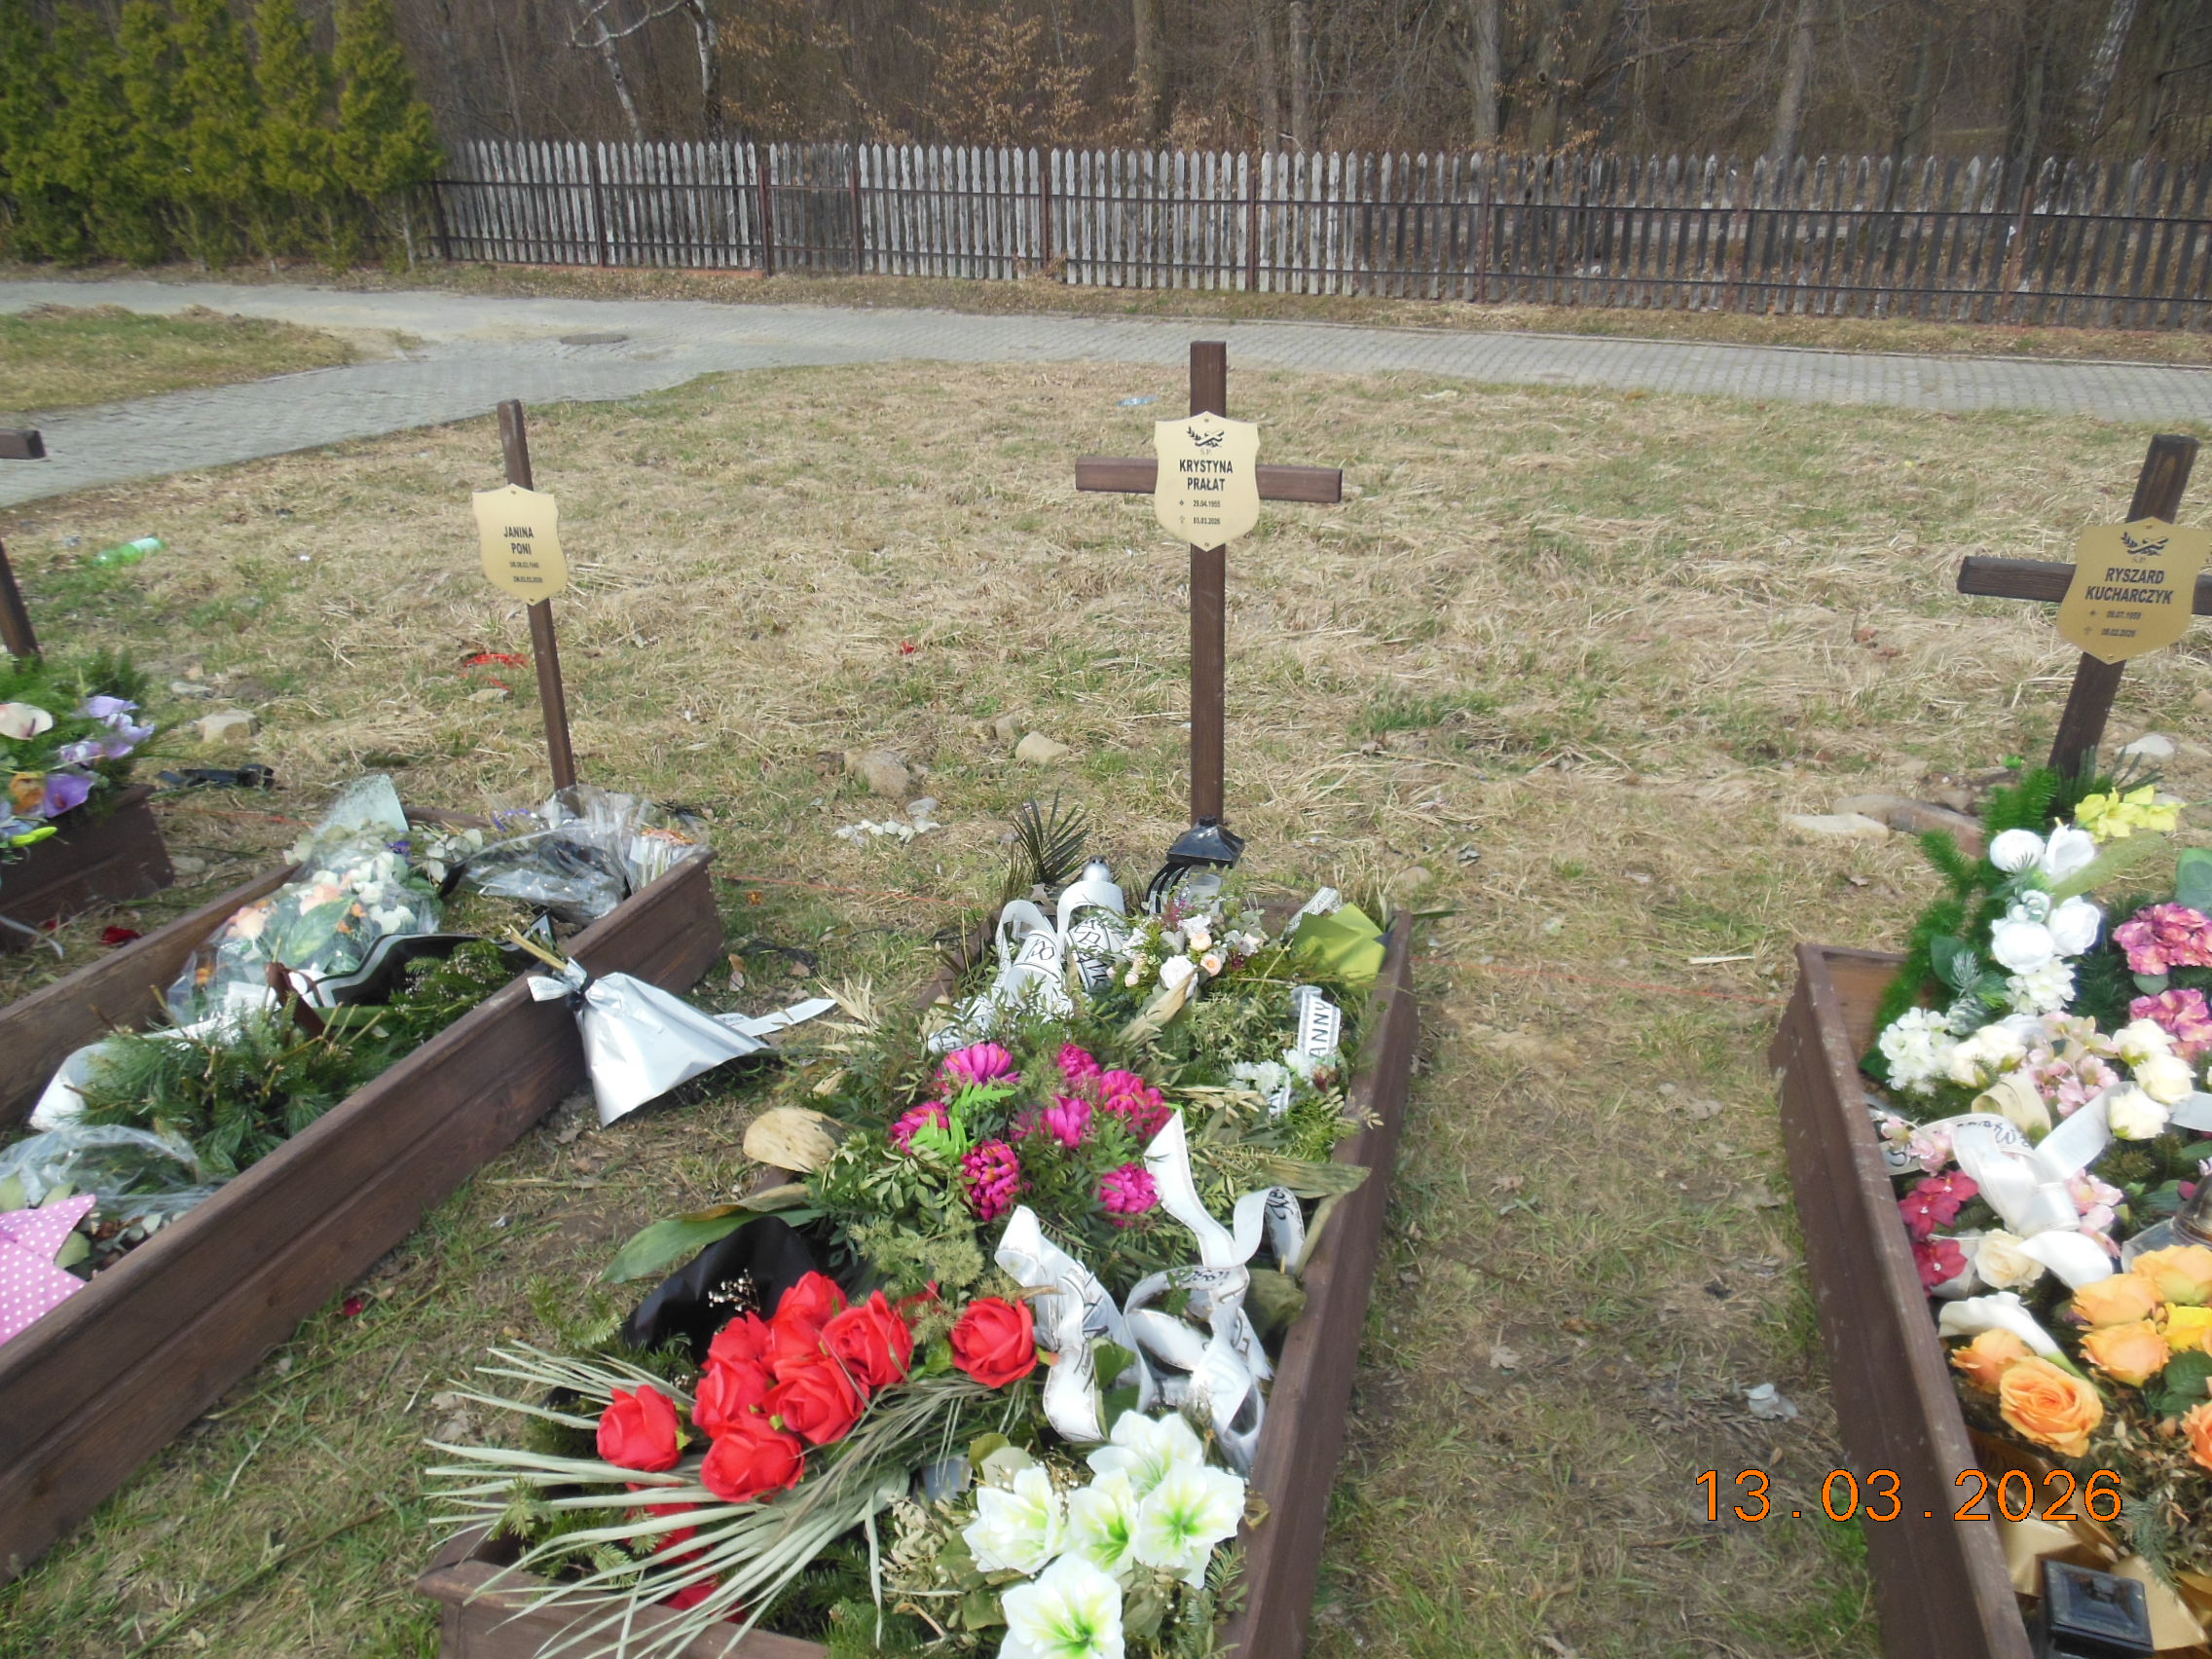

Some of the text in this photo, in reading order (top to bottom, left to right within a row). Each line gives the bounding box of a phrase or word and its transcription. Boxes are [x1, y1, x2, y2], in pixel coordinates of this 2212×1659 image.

[1179, 459, 1234, 474] KRYSTYNA
[1187, 476, 1226, 492] PRAŁAT
[503, 526, 535, 538] JANINA
[511, 542, 532, 555] PONI
[2105, 567, 2165, 585] RYSZARD
[2084, 585, 2174, 605] KUCHARCZYK
